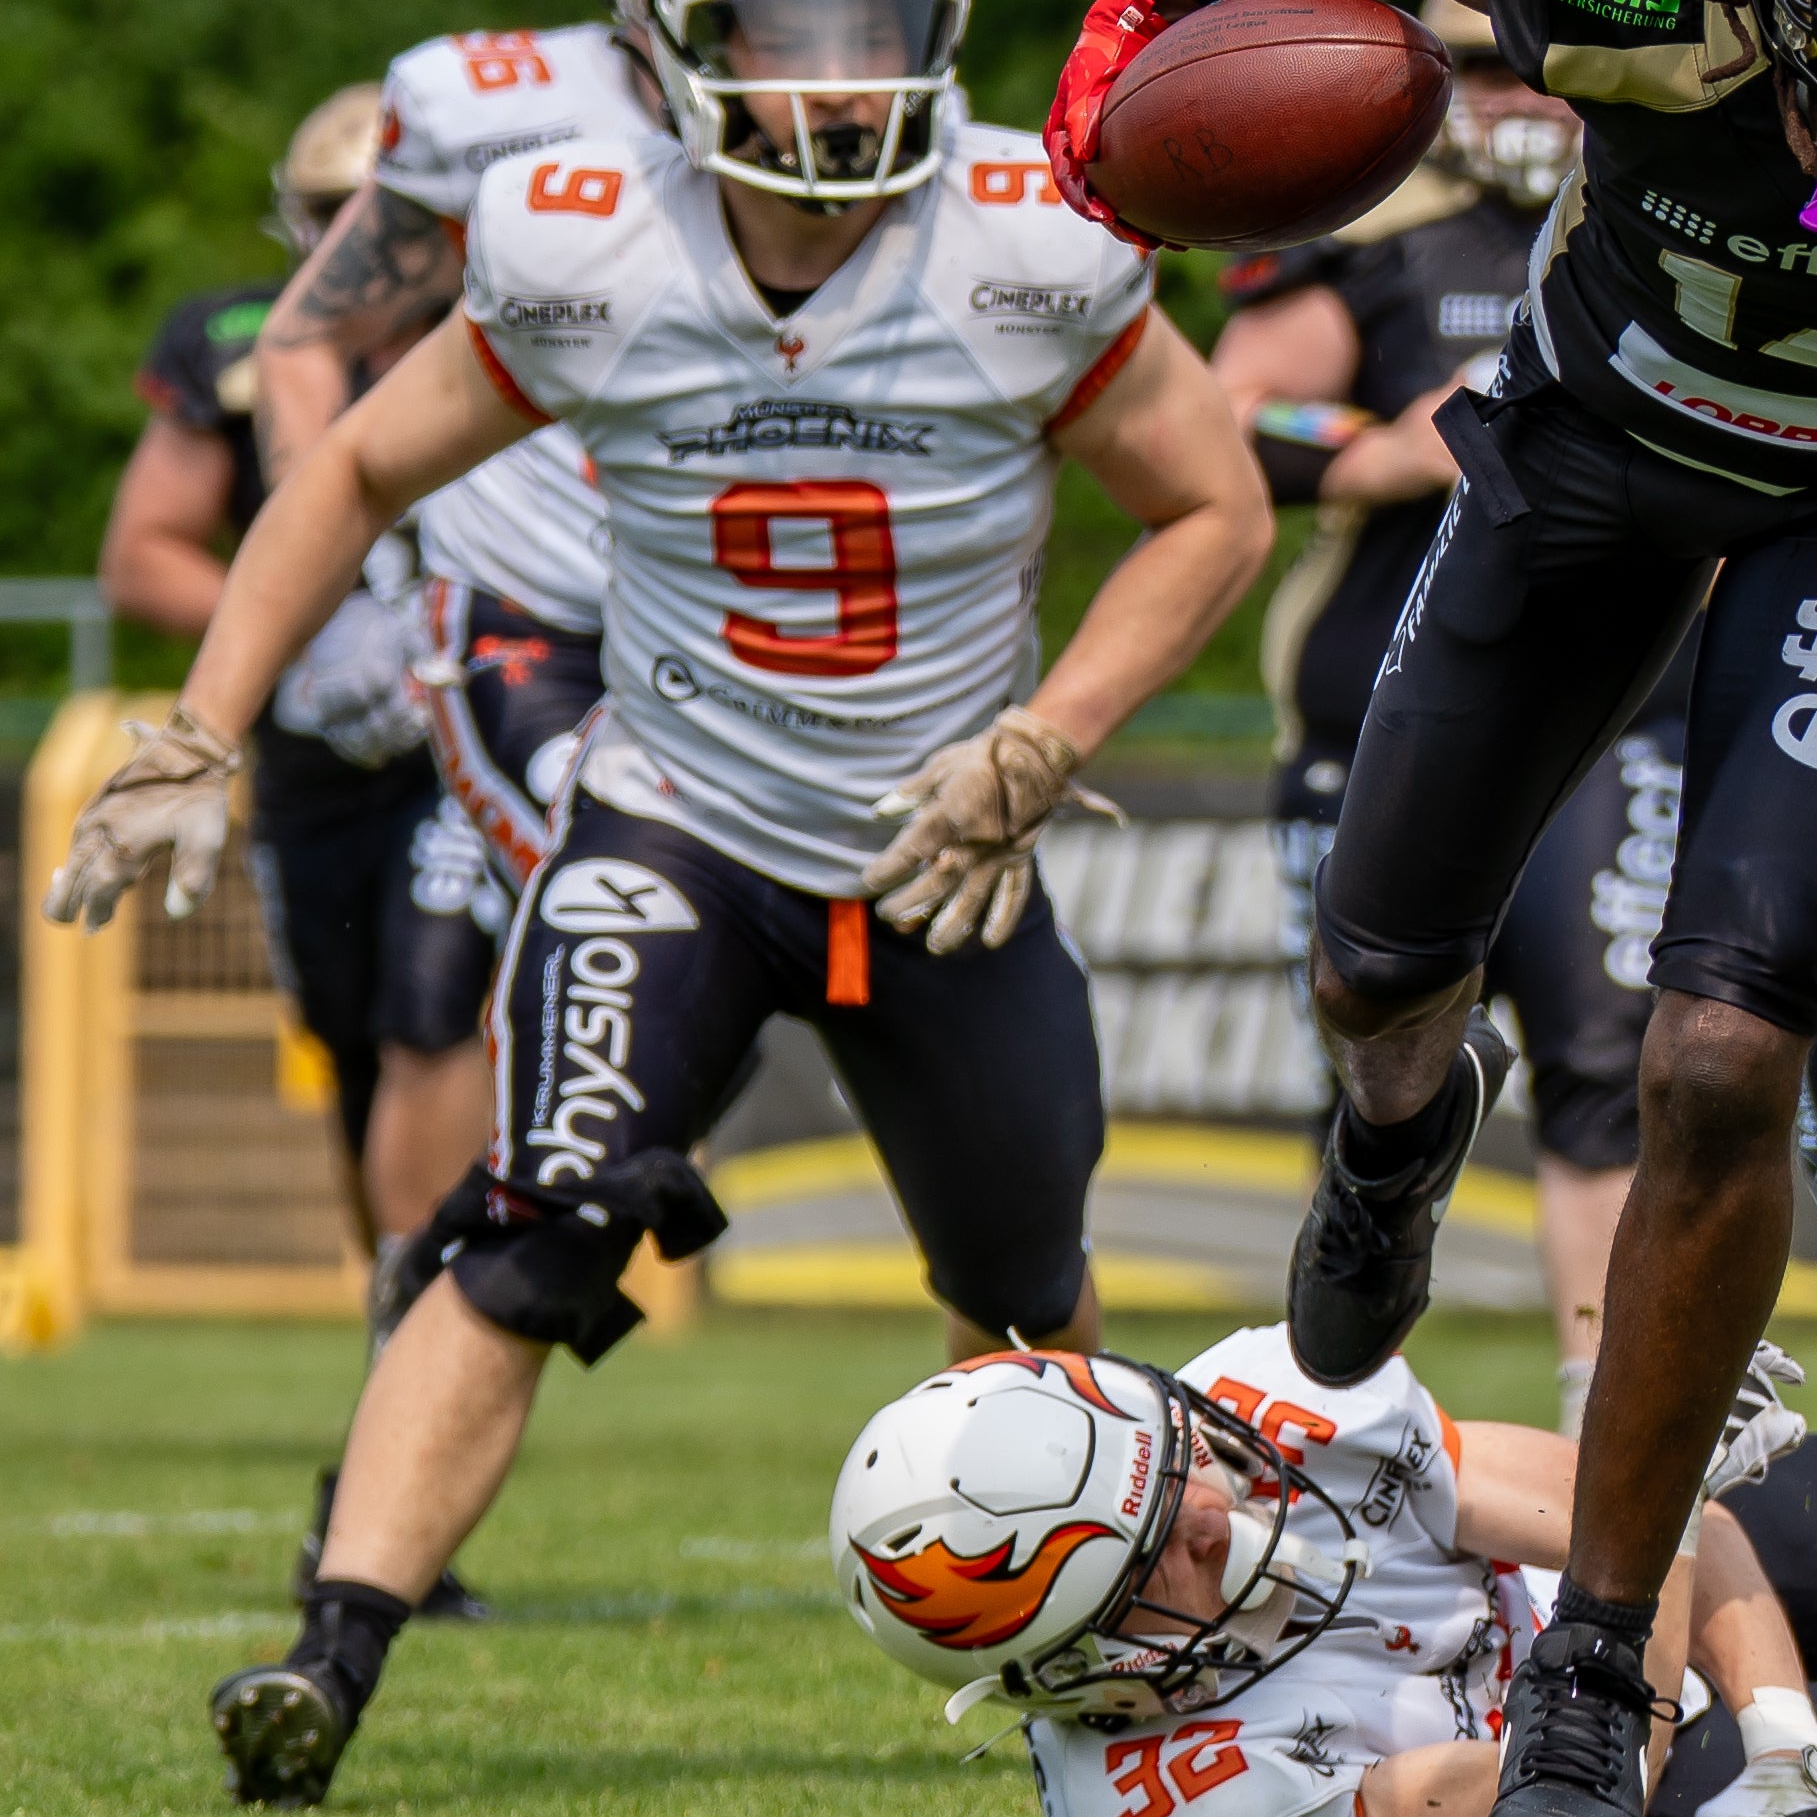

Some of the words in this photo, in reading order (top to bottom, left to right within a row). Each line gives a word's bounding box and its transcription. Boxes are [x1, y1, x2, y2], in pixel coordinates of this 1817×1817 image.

[526, 163, 623, 217] 9
[502, 298, 612, 328] CINEPLEX
[656, 414, 936, 467] PHOENIX
[708, 477, 898, 676] 9
[1121, 1430, 1153, 1518] Riddell
[1361, 1427, 1432, 1527] CINEEX
